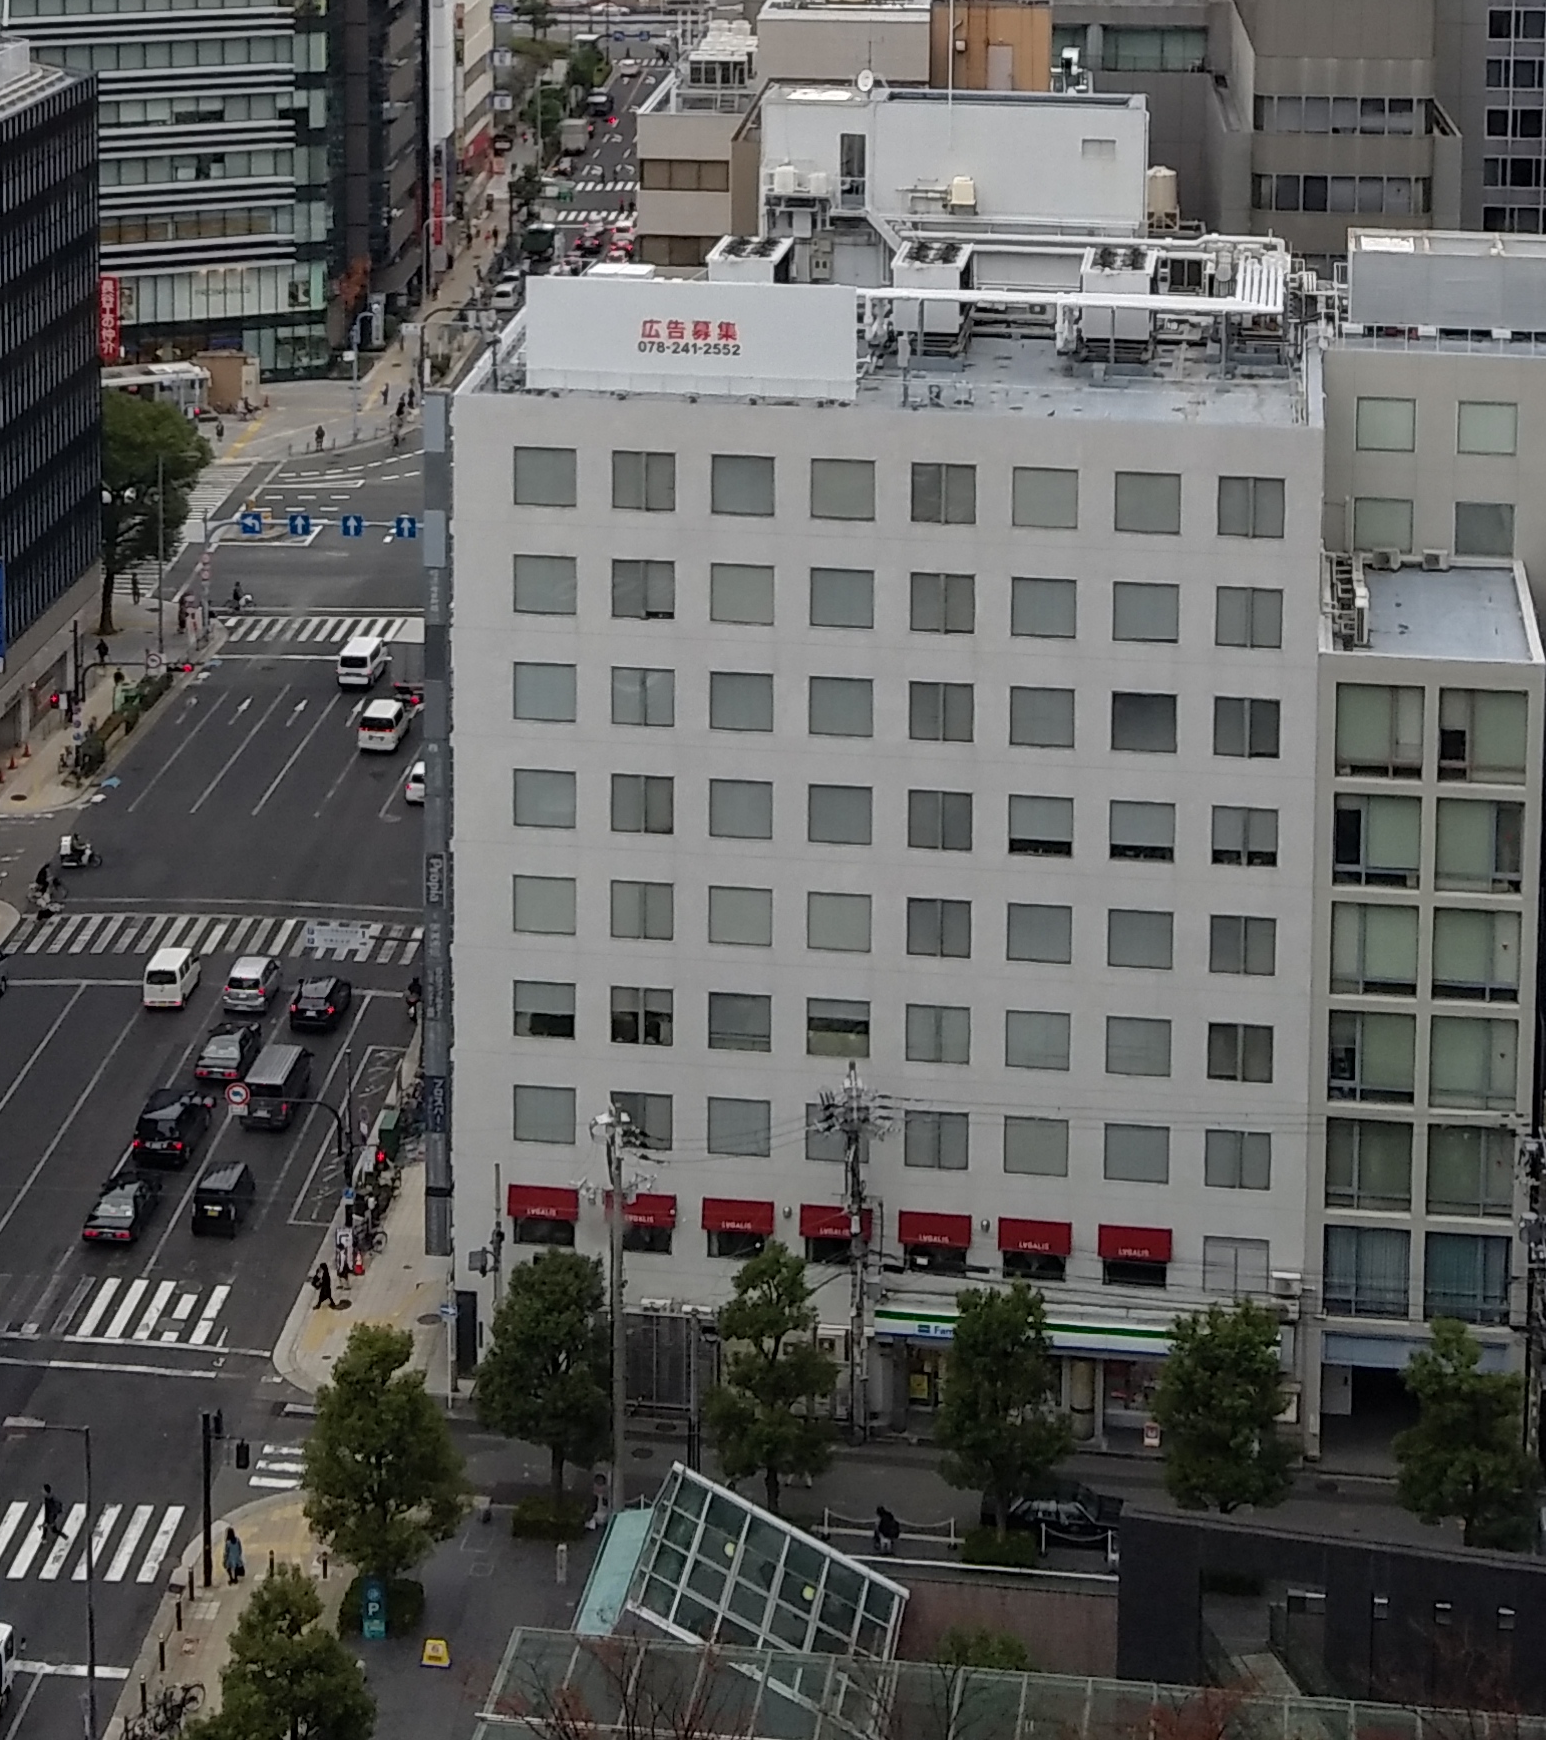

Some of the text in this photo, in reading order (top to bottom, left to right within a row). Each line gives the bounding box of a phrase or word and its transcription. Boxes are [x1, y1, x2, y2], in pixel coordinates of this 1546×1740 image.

[100, 280, 116, 355] 長谷工の仲介
[641, 318, 737, 341] 広告募集
[638, 341, 741, 356] 078-241-2552
[367, 1602, 380, 1616] P
